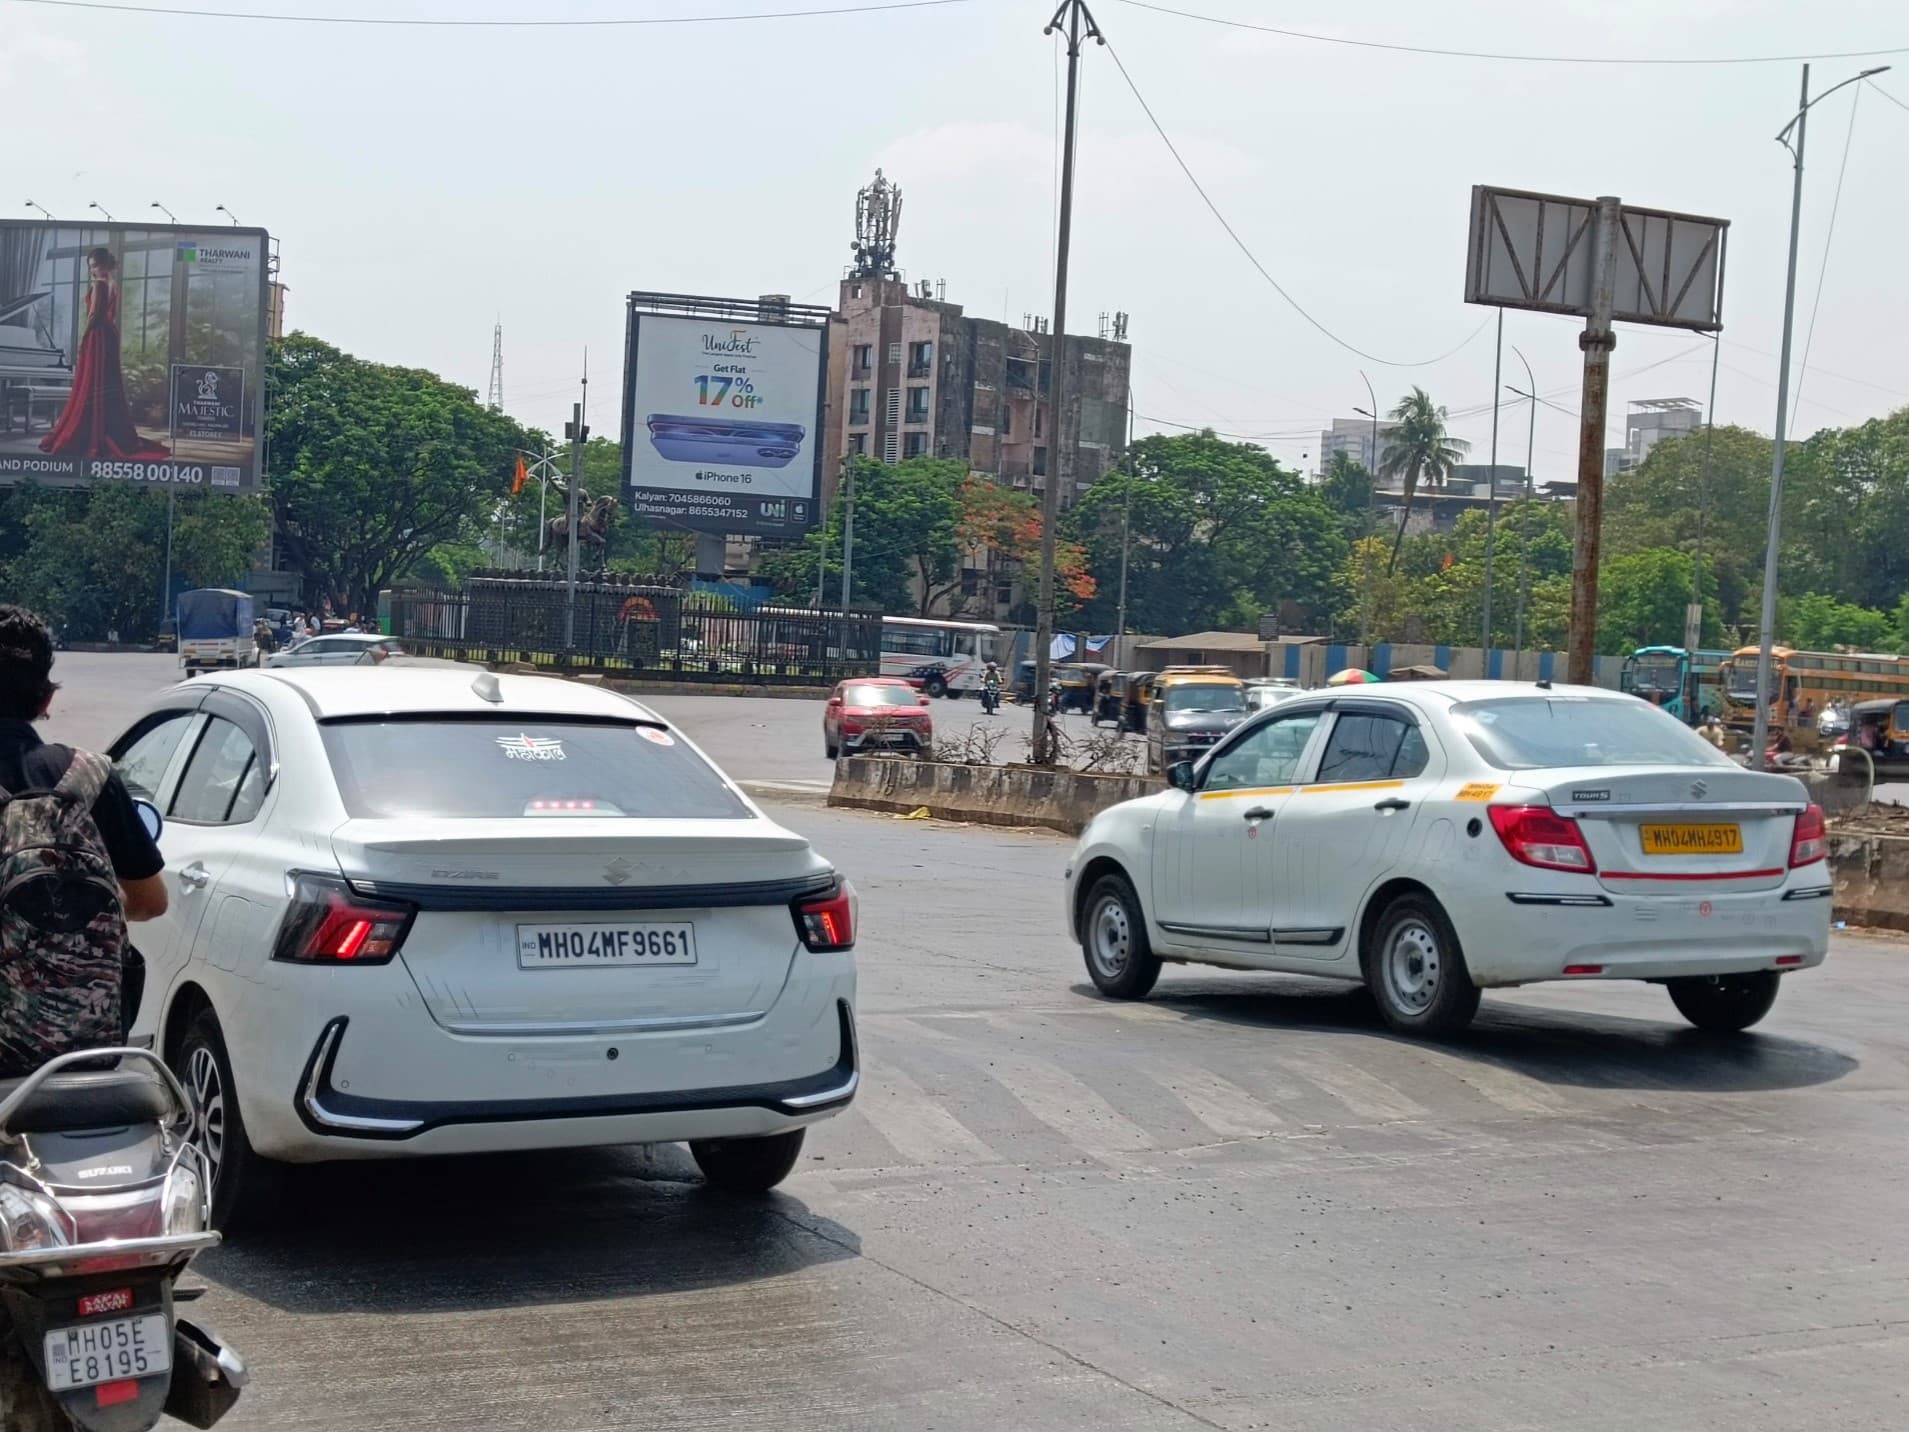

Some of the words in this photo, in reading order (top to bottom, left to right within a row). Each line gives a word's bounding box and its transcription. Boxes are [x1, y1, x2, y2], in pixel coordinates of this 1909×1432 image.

[200, 249, 250, 259] THARWANI
[714, 364, 728, 373] Get
[730, 365, 746, 374] Flat
[694, 375, 754, 406] 17%
[179, 402, 235, 418] MAJESTIC
[23, 460, 73, 472] PODIUM
[90, 462, 144, 480] 88558
[146, 464, 203, 483] 00140
[704, 472, 739, 482] iPhone
[740, 474, 752, 484] 16
[635, 492, 668, 502] Kalyan:
[668, 494, 731, 506] 7045866060
[634, 503, 687, 514] Ulhasnagar:
[689, 507, 748, 518] 8655347152
[500, 743, 568, 762] महाकाल
[1653, 829, 1737, 848] MH04MH4917
[431, 869, 500, 880] DZIRE
[537, 930, 689, 959] MH04MF9661
[78, 1166, 132, 1179] SUZUKI
[67, 1317, 146, 1356] MH05E
[70, 1350, 148, 1384] E8195
